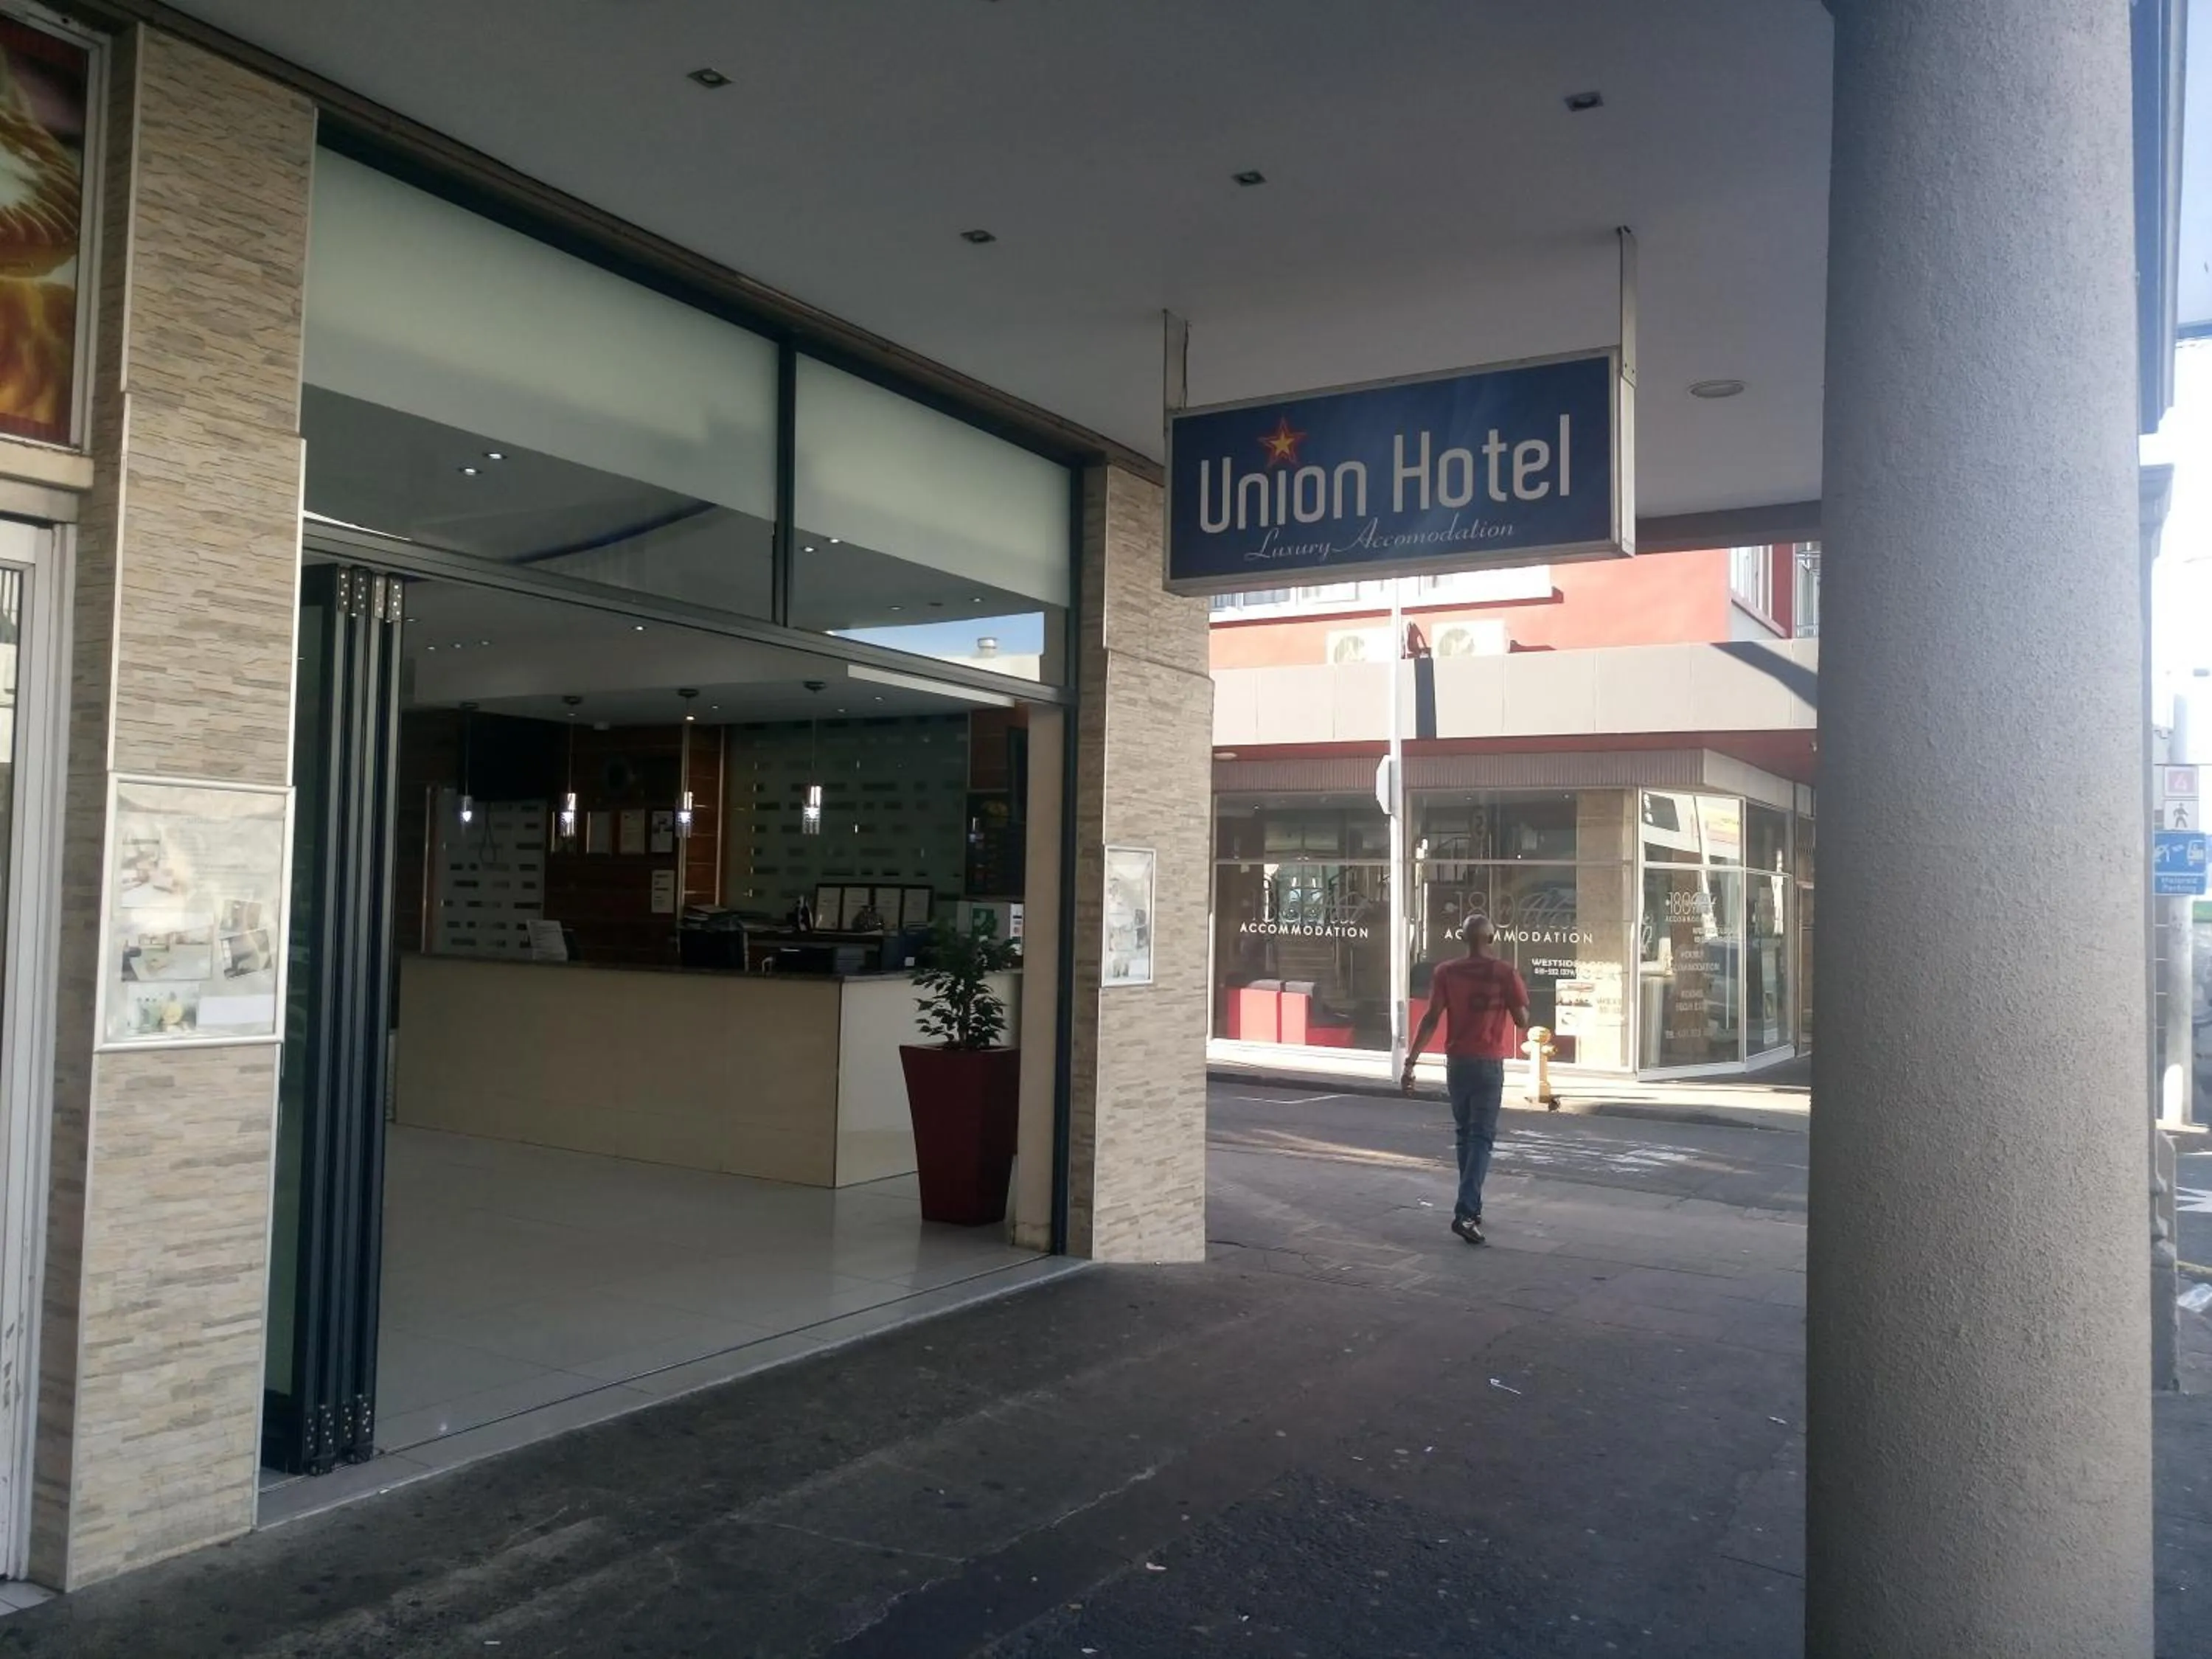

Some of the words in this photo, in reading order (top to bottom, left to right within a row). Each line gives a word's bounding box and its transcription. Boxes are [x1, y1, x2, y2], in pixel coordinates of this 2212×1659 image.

[1200, 456, 1367, 534] Union
[1393, 414, 1571, 512] Hotel
[1244, 528, 1331, 562] Luxury
[1332, 515, 1516, 553] Accomodation
[1239, 922, 1369, 939] ACCOMMODATION
[1443, 928, 1594, 945] ACMMODATION
